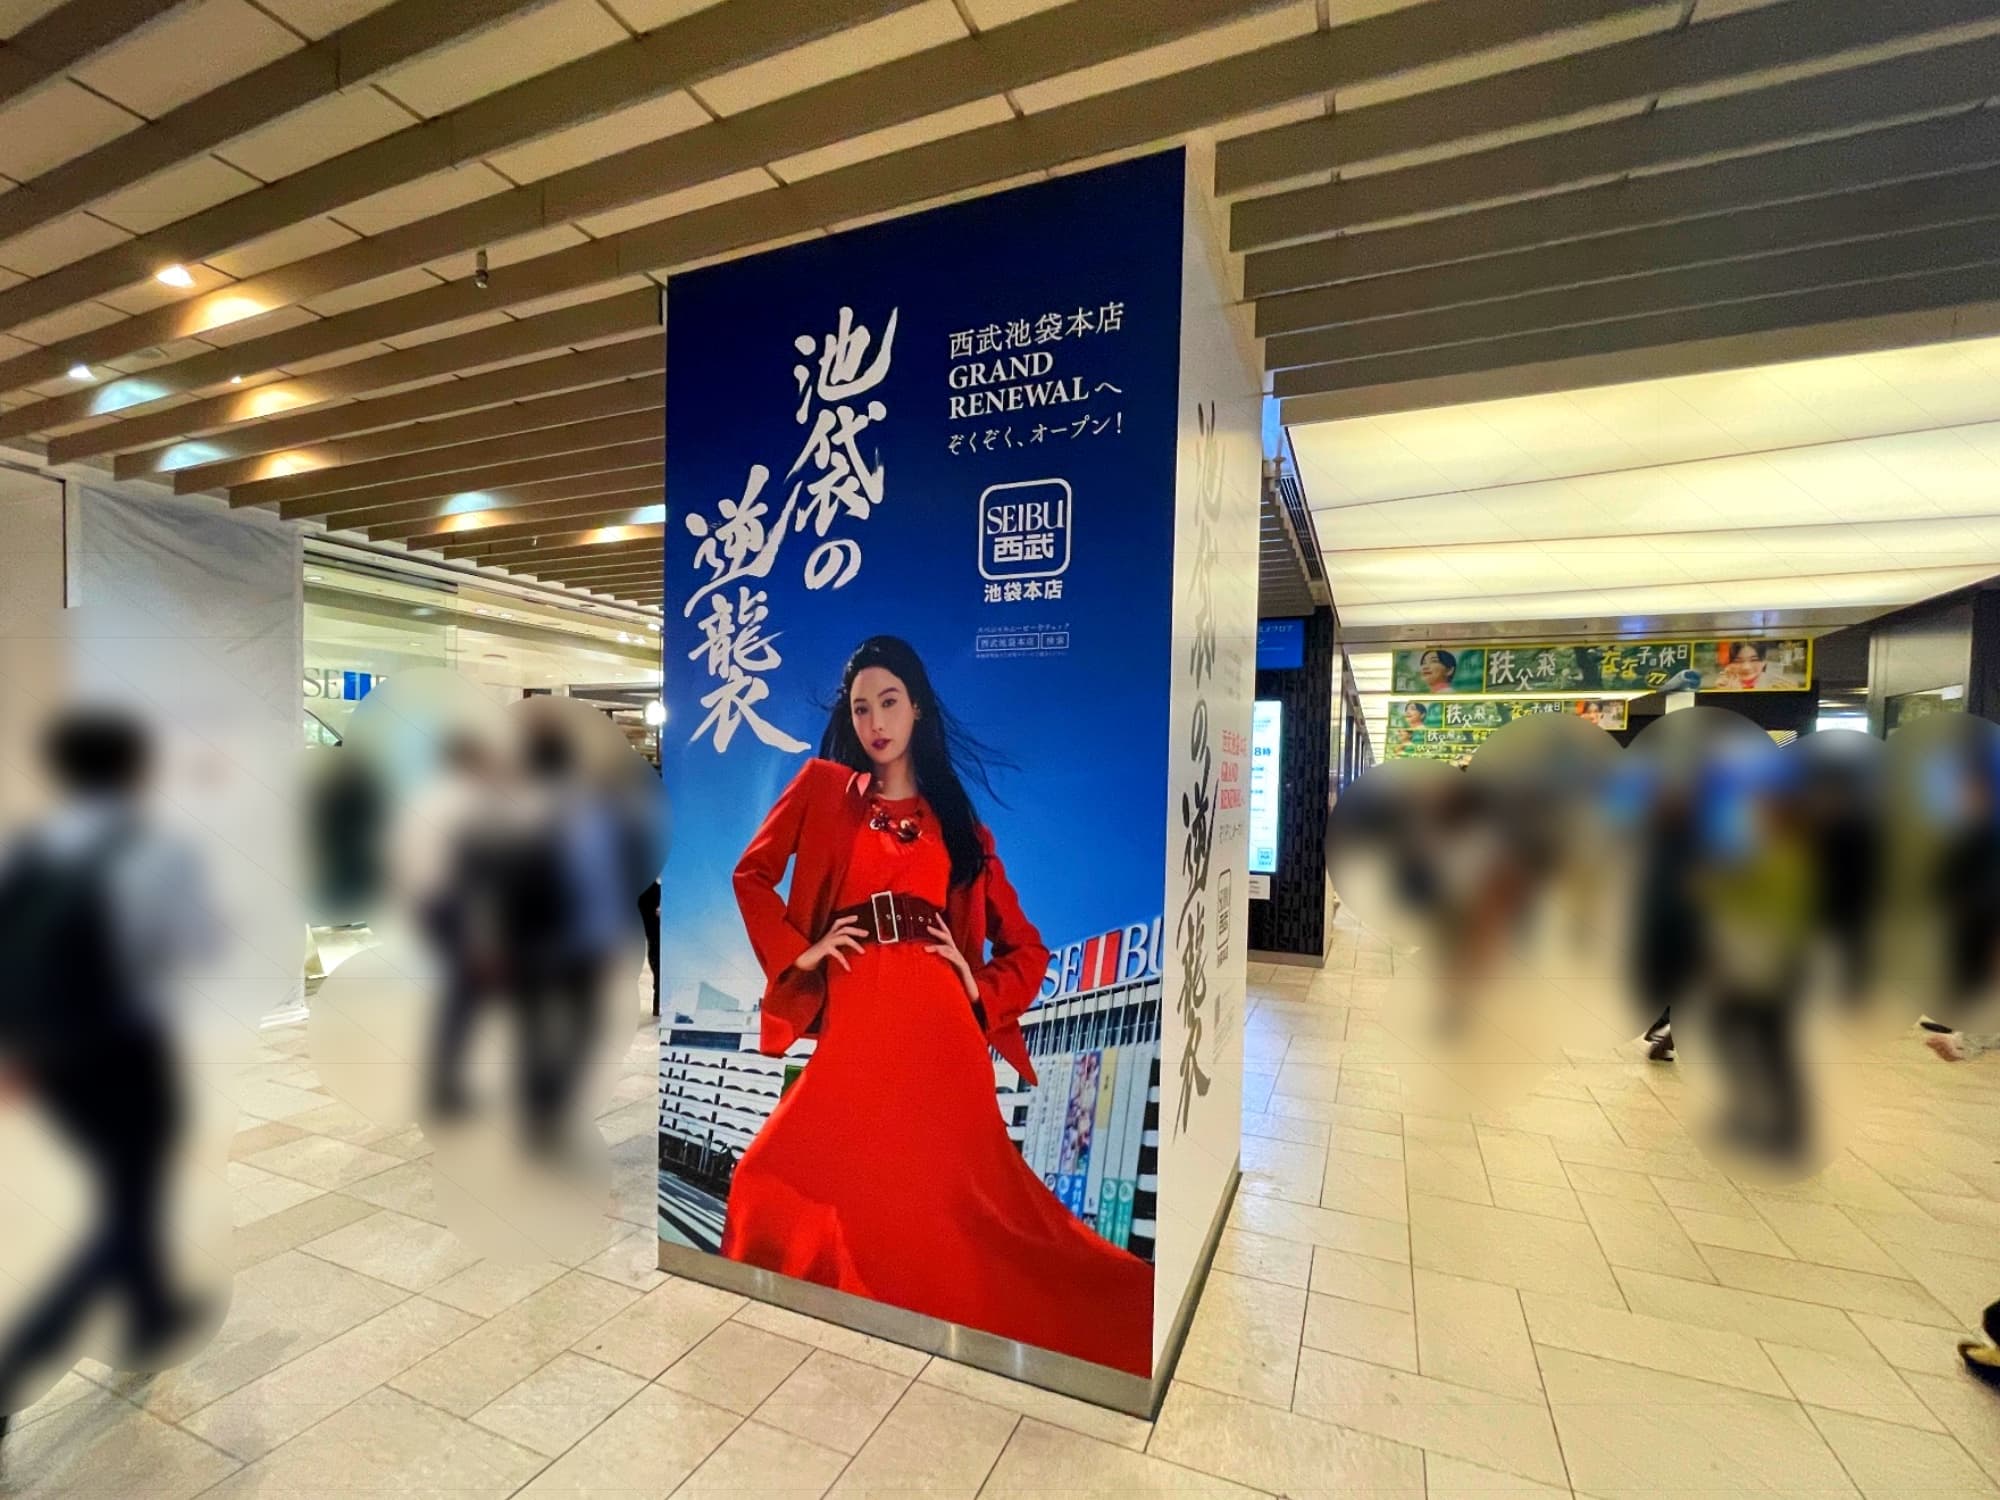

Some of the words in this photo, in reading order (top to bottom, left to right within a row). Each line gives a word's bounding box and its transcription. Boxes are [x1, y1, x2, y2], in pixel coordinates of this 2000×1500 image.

[949, 301, 1124, 360] 西武池袋本店
[949, 352, 1053, 389] GRAND
[784, 306, 898, 591] 池袋の
[948, 411, 1122, 455] ぞくぞく、オープン！
[986, 500, 1065, 535] SEIBU
[993, 532, 1055, 563] 西武
[984, 579, 1064, 603] 池袋本店
[304, 667, 389, 700] SEI
